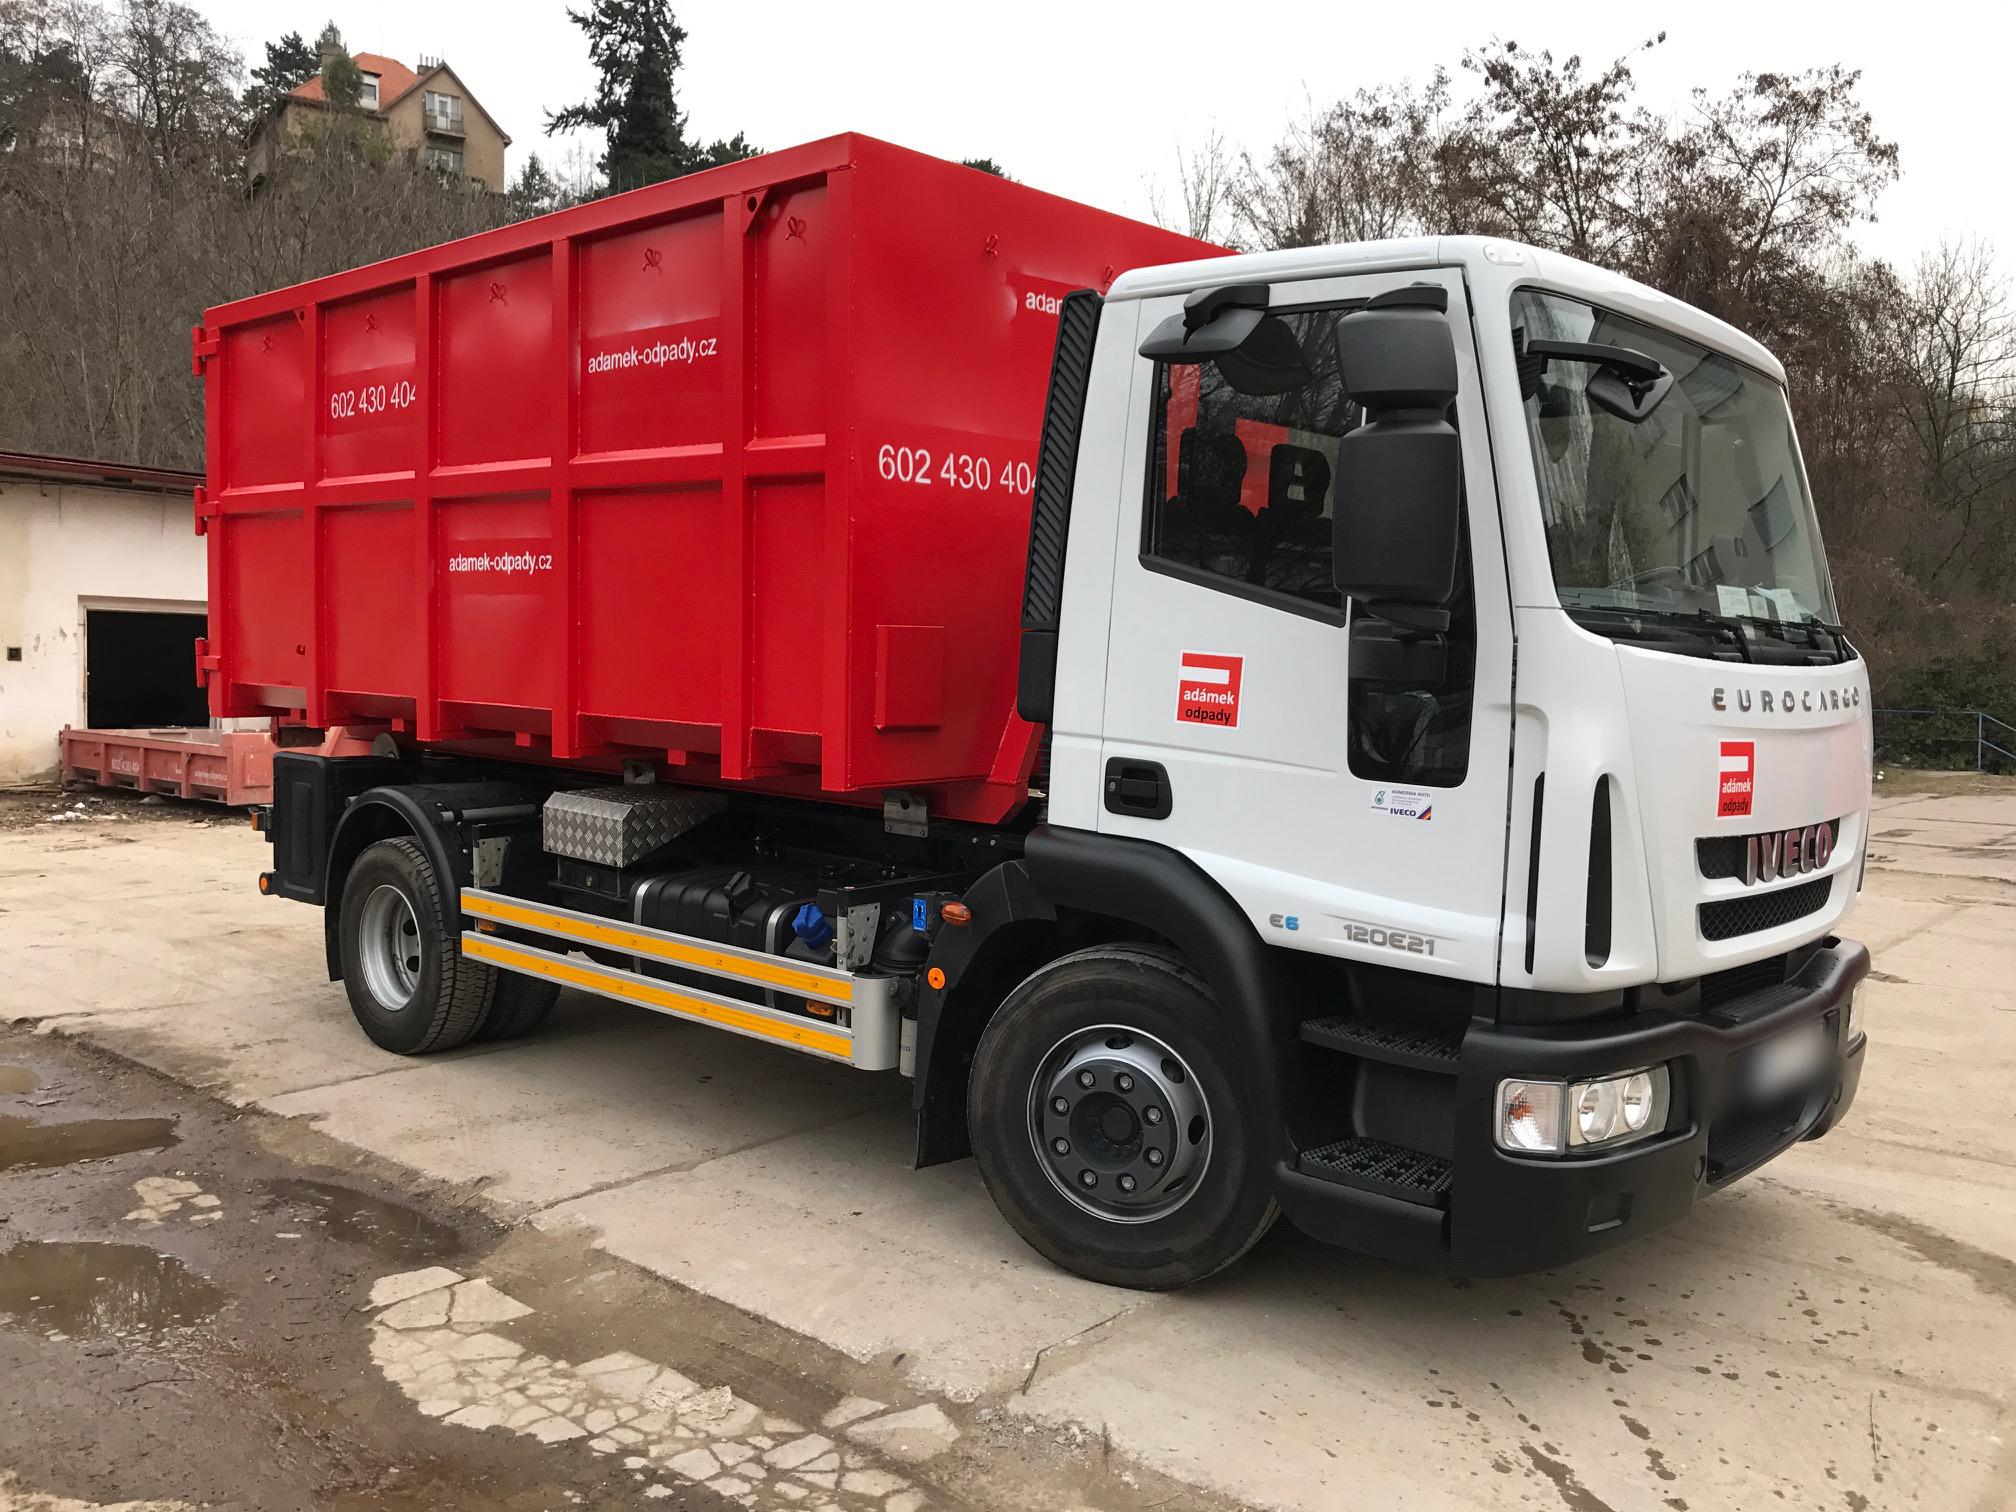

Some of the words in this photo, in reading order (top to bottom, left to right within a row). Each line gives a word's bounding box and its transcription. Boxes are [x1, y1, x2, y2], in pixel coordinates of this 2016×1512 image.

[588, 336, 717, 374] adamek-odpady.cz
[331, 393, 355, 419] 602
[358, 384, 386, 414] 430
[878, 444, 932, 484] 602
[940, 453, 991, 491] 430
[449, 551, 552, 575] adamek-odpady.cz
[1183, 687, 1235, 705] adámek
[1711, 686, 1860, 713] EUROCARGO
[1185, 706, 1231, 725] odpady
[1722, 778, 1751, 794] adámek
[1390, 807, 1417, 817] IVECO
[1722, 797, 1749, 815] odpady
[1746, 822, 1833, 887] IVECO
[1343, 923, 1435, 956] 120E21
